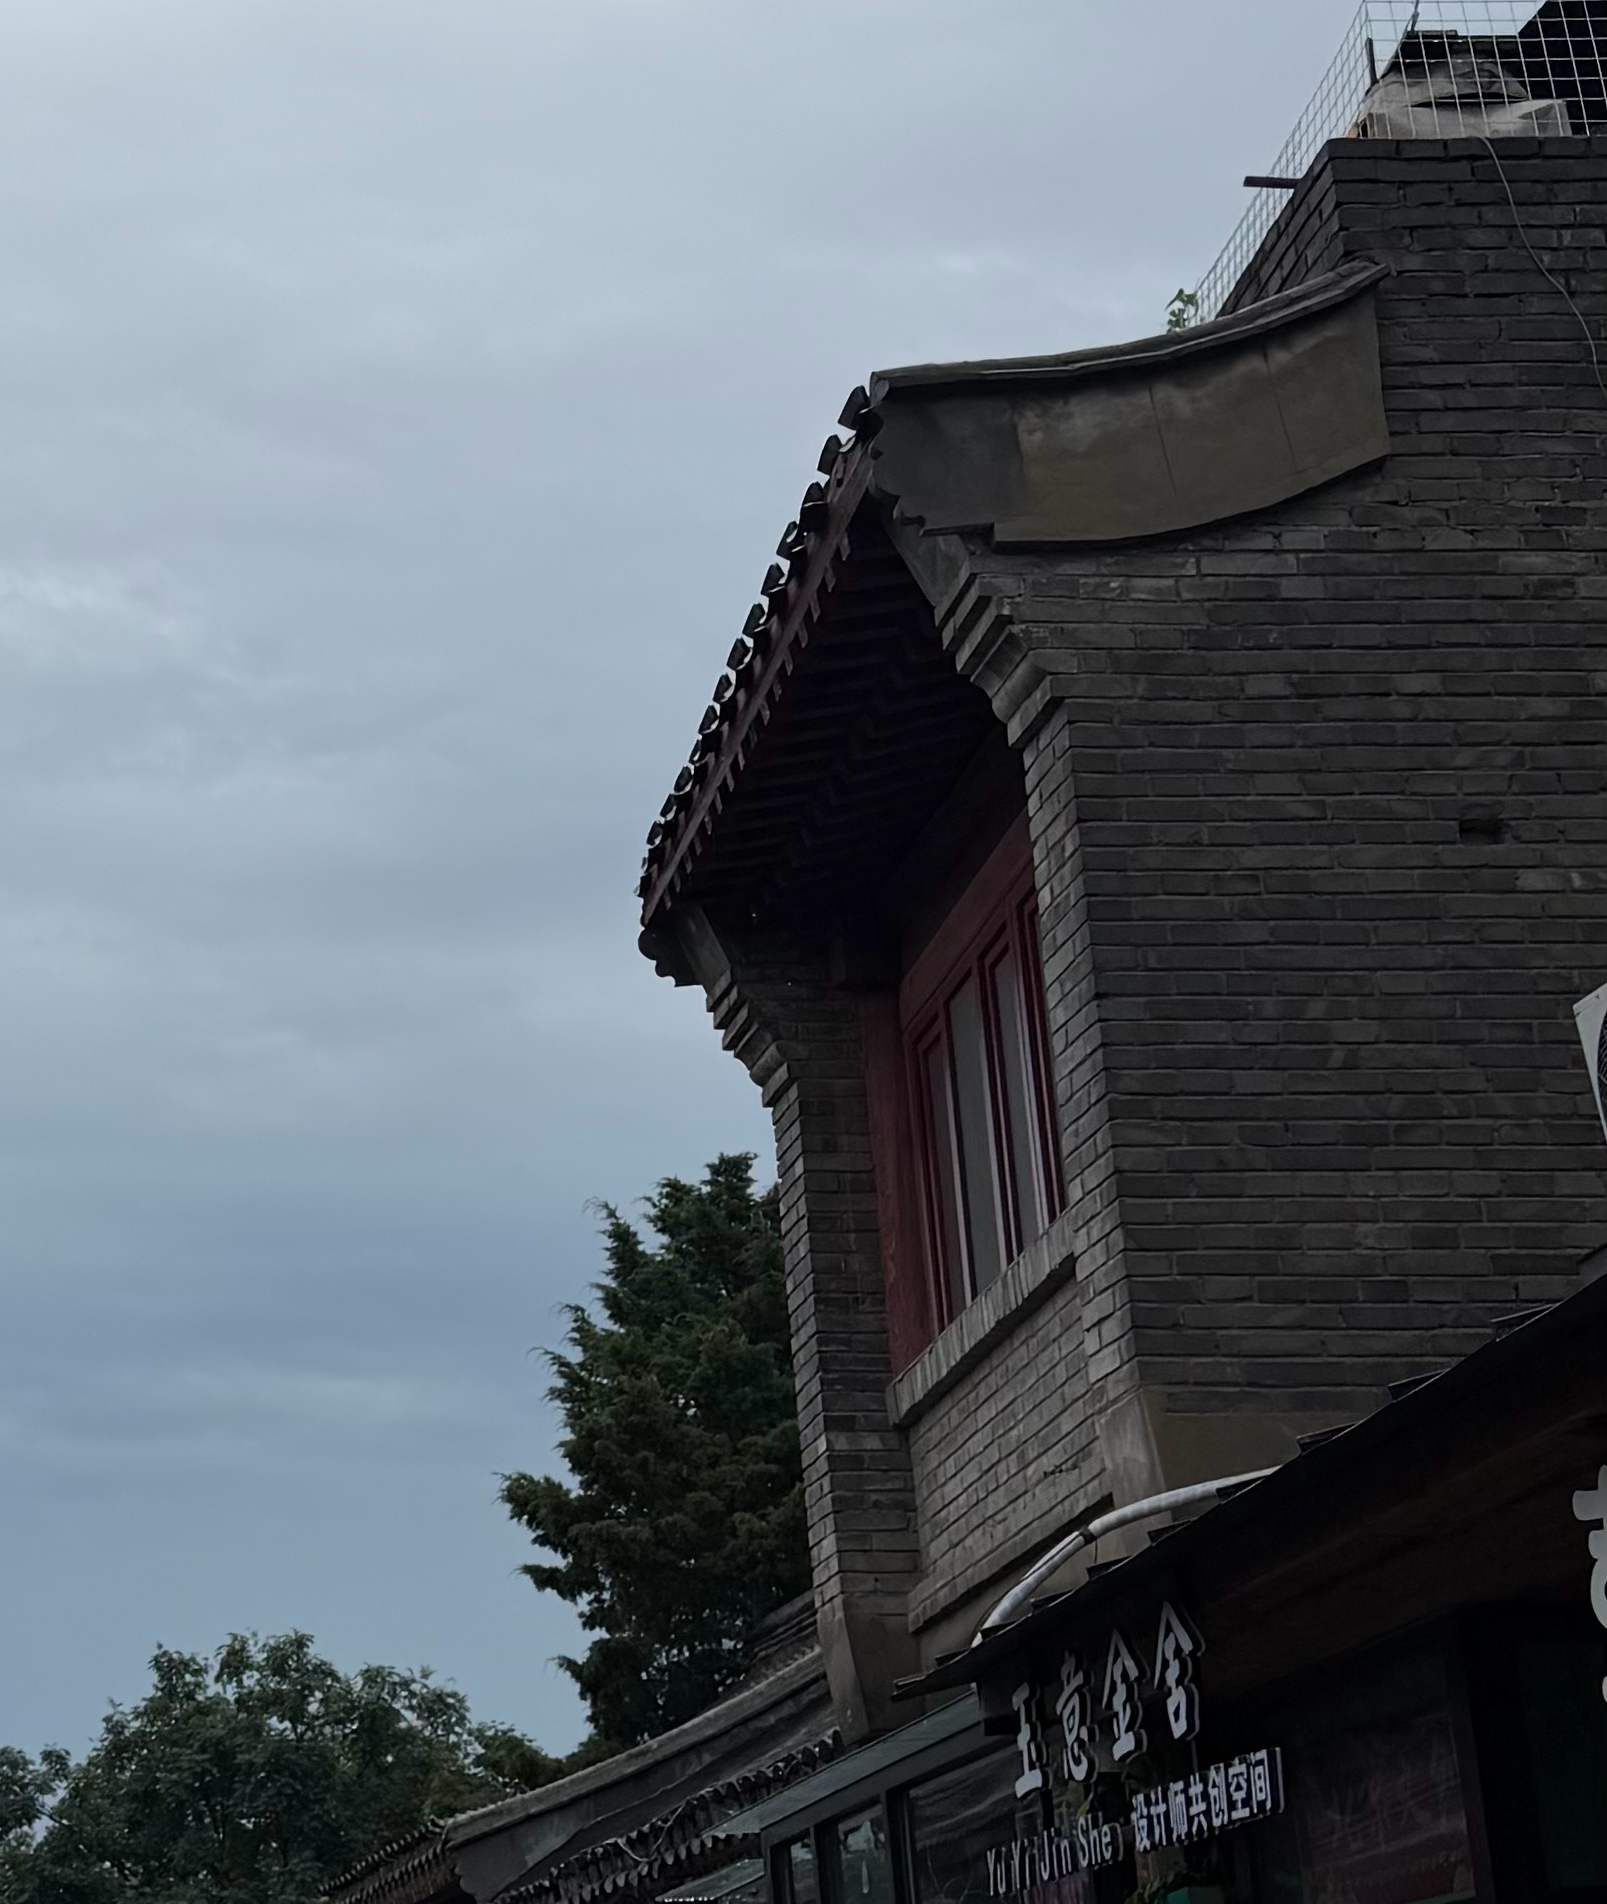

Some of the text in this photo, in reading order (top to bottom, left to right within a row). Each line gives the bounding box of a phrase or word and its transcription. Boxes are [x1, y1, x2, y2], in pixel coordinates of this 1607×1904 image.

[1011, 1601, 1194, 1798] 玉意金舍
[1130, 1749, 1272, 1853] 设计师共创空间
[986, 1812, 1113, 1896] Yu Yi Jin She
